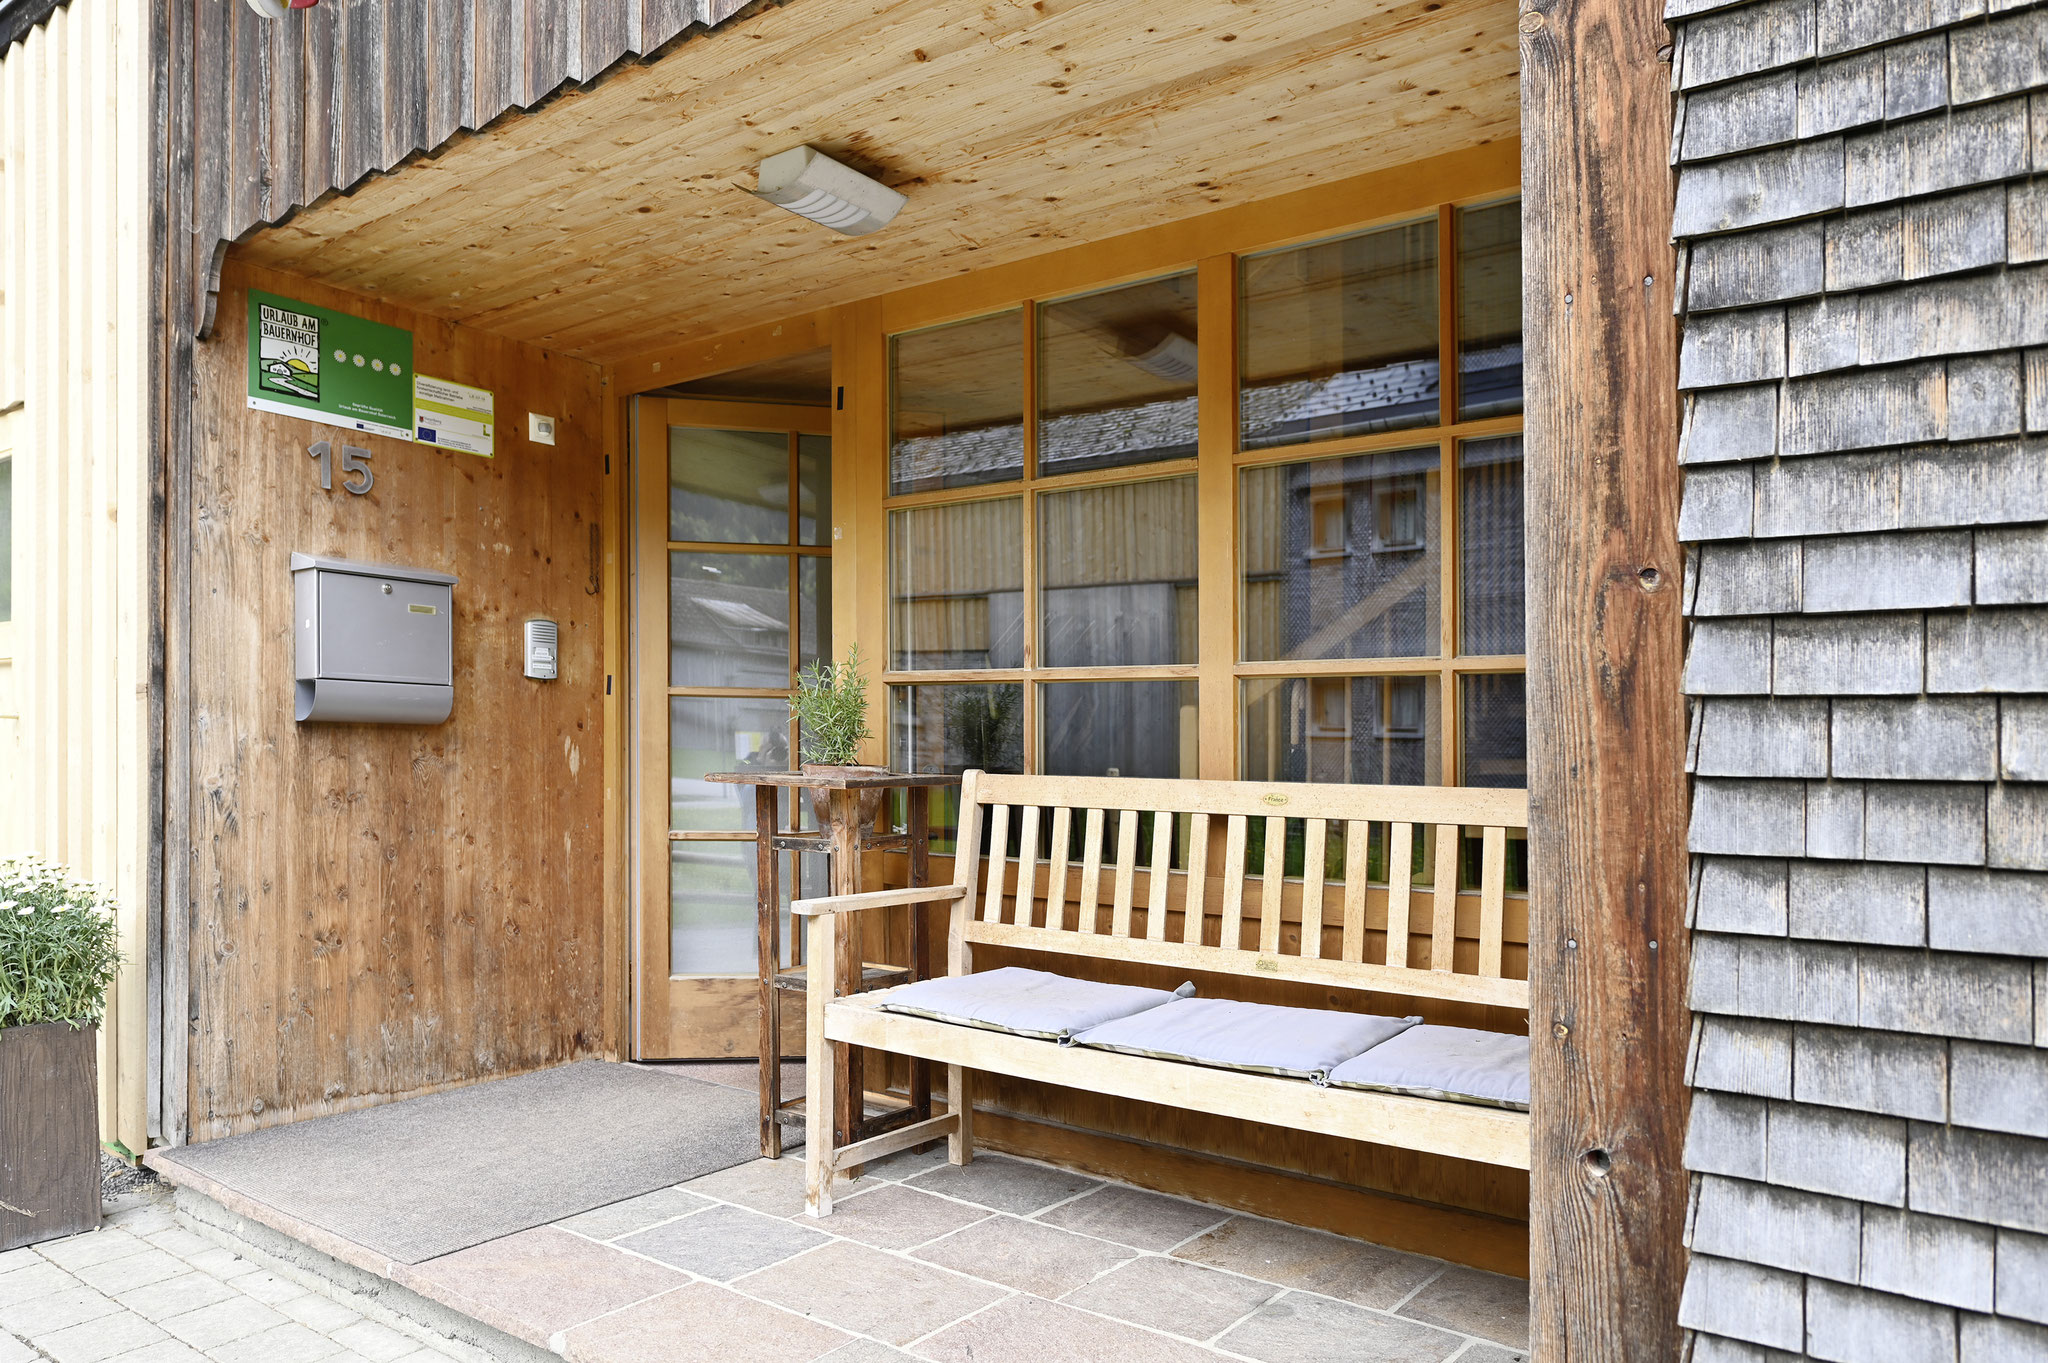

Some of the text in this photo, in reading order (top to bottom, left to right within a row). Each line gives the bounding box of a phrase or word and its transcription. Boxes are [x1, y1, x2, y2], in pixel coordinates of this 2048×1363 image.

[263, 307, 316, 331] URLAUB AM
[263, 322, 316, 346] BAUERNHOF
[307, 441, 373, 495] 15
